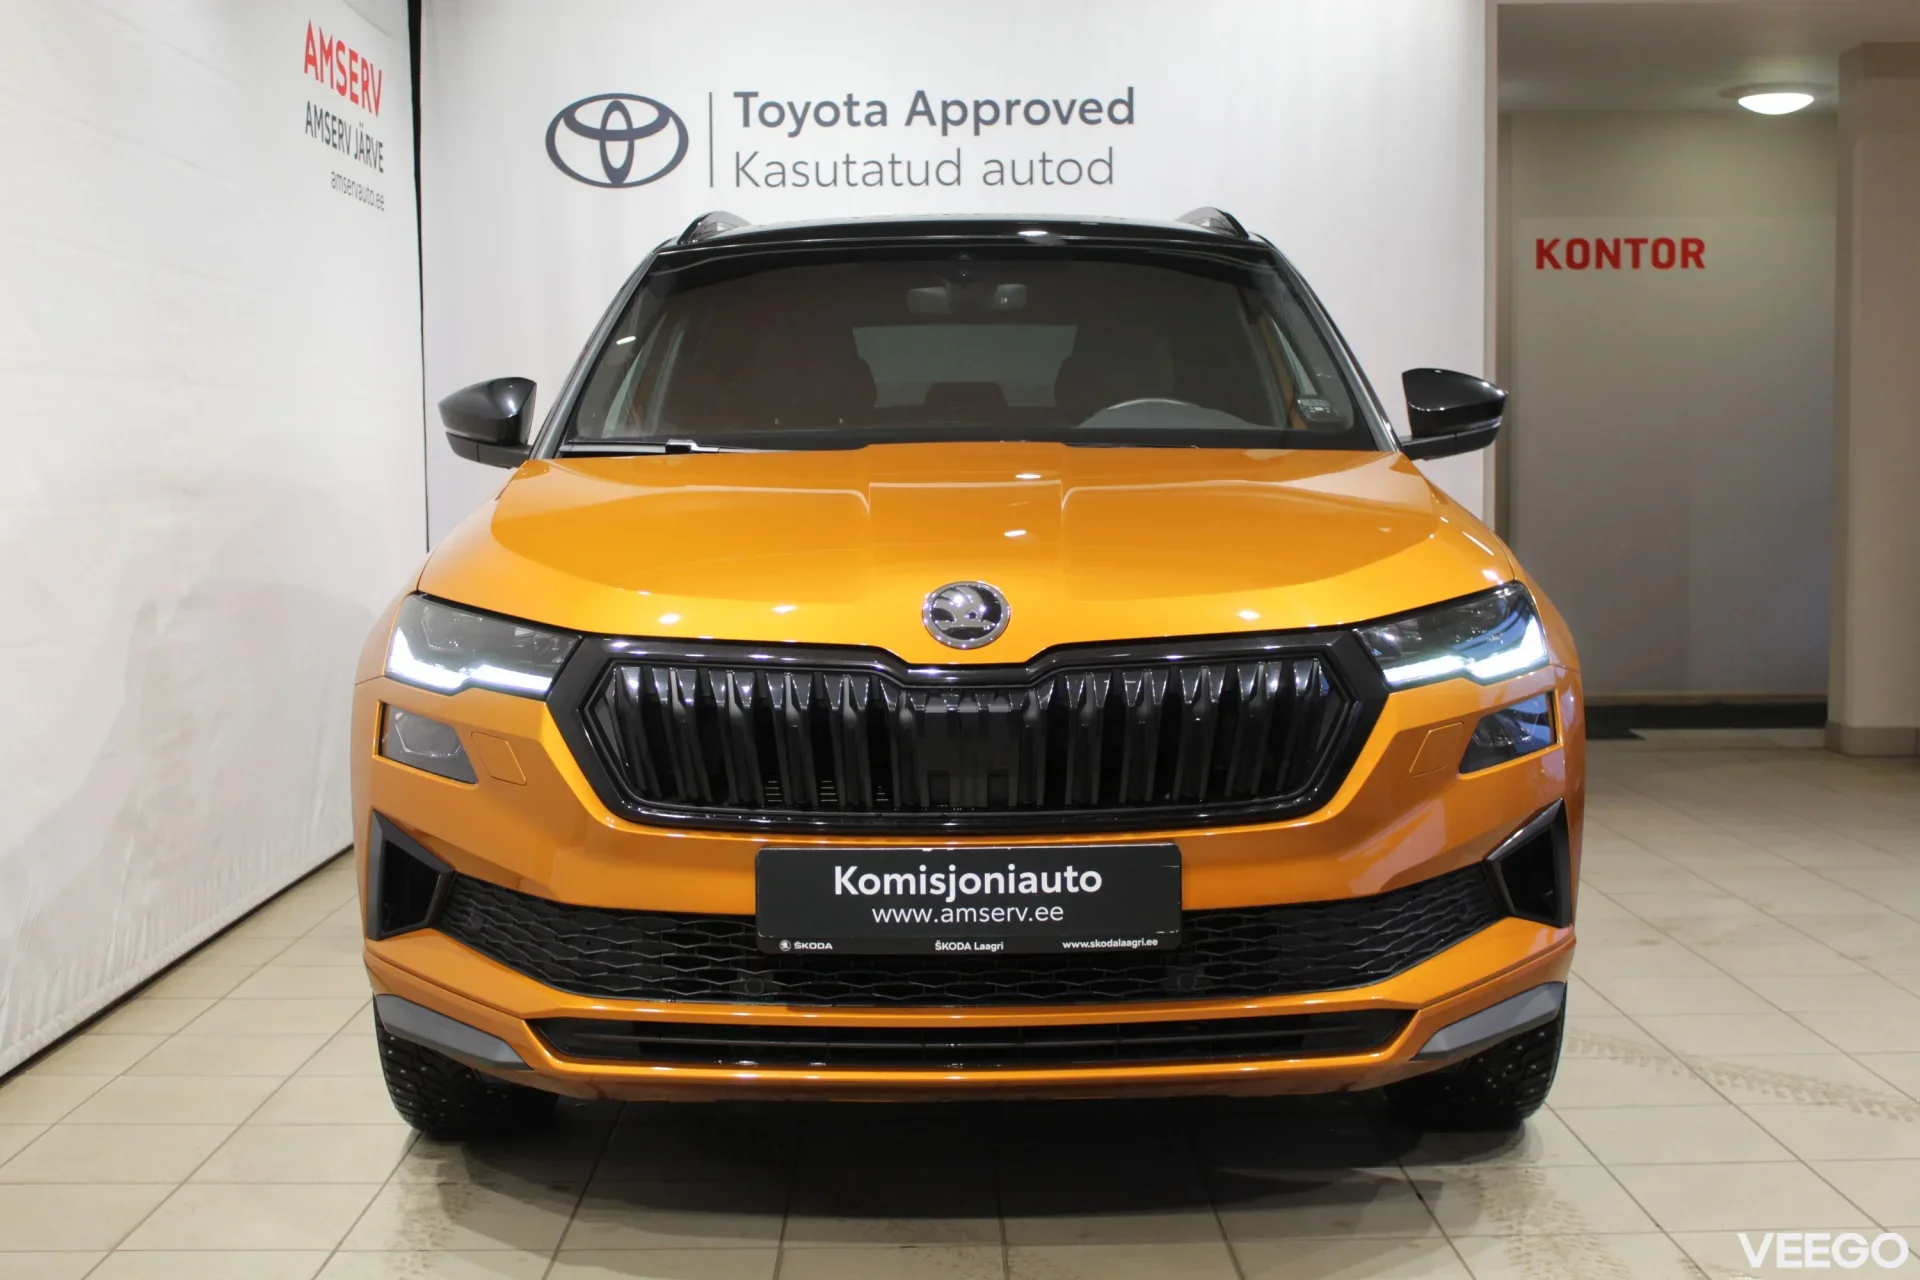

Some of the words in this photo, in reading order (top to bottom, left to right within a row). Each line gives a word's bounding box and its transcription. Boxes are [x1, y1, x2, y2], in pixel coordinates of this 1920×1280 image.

[304, 19, 382, 118] AMSERV
[734, 91, 888, 138] Toyota
[905, 87, 1135, 135] Approved
[305, 101, 351, 156] AMSERV
[353, 121, 384, 174] JÄRVE
[735, 149, 962, 188] Kasutatud
[982, 147, 1115, 185] autod
[330, 170, 385, 211] amservauto.ee
[1536, 237, 1706, 270] KONTOR
[834, 864, 1102, 902] Komisjoniauto
[872, 904, 1064, 924] www.amserv.ee
[793, 941, 834, 951] ŠKODA
[934, 940, 972, 951] ŠKODA
[973, 941, 1005, 952] Laagri
[1061, 937, 1159, 950] www.skodalaagri.ee
